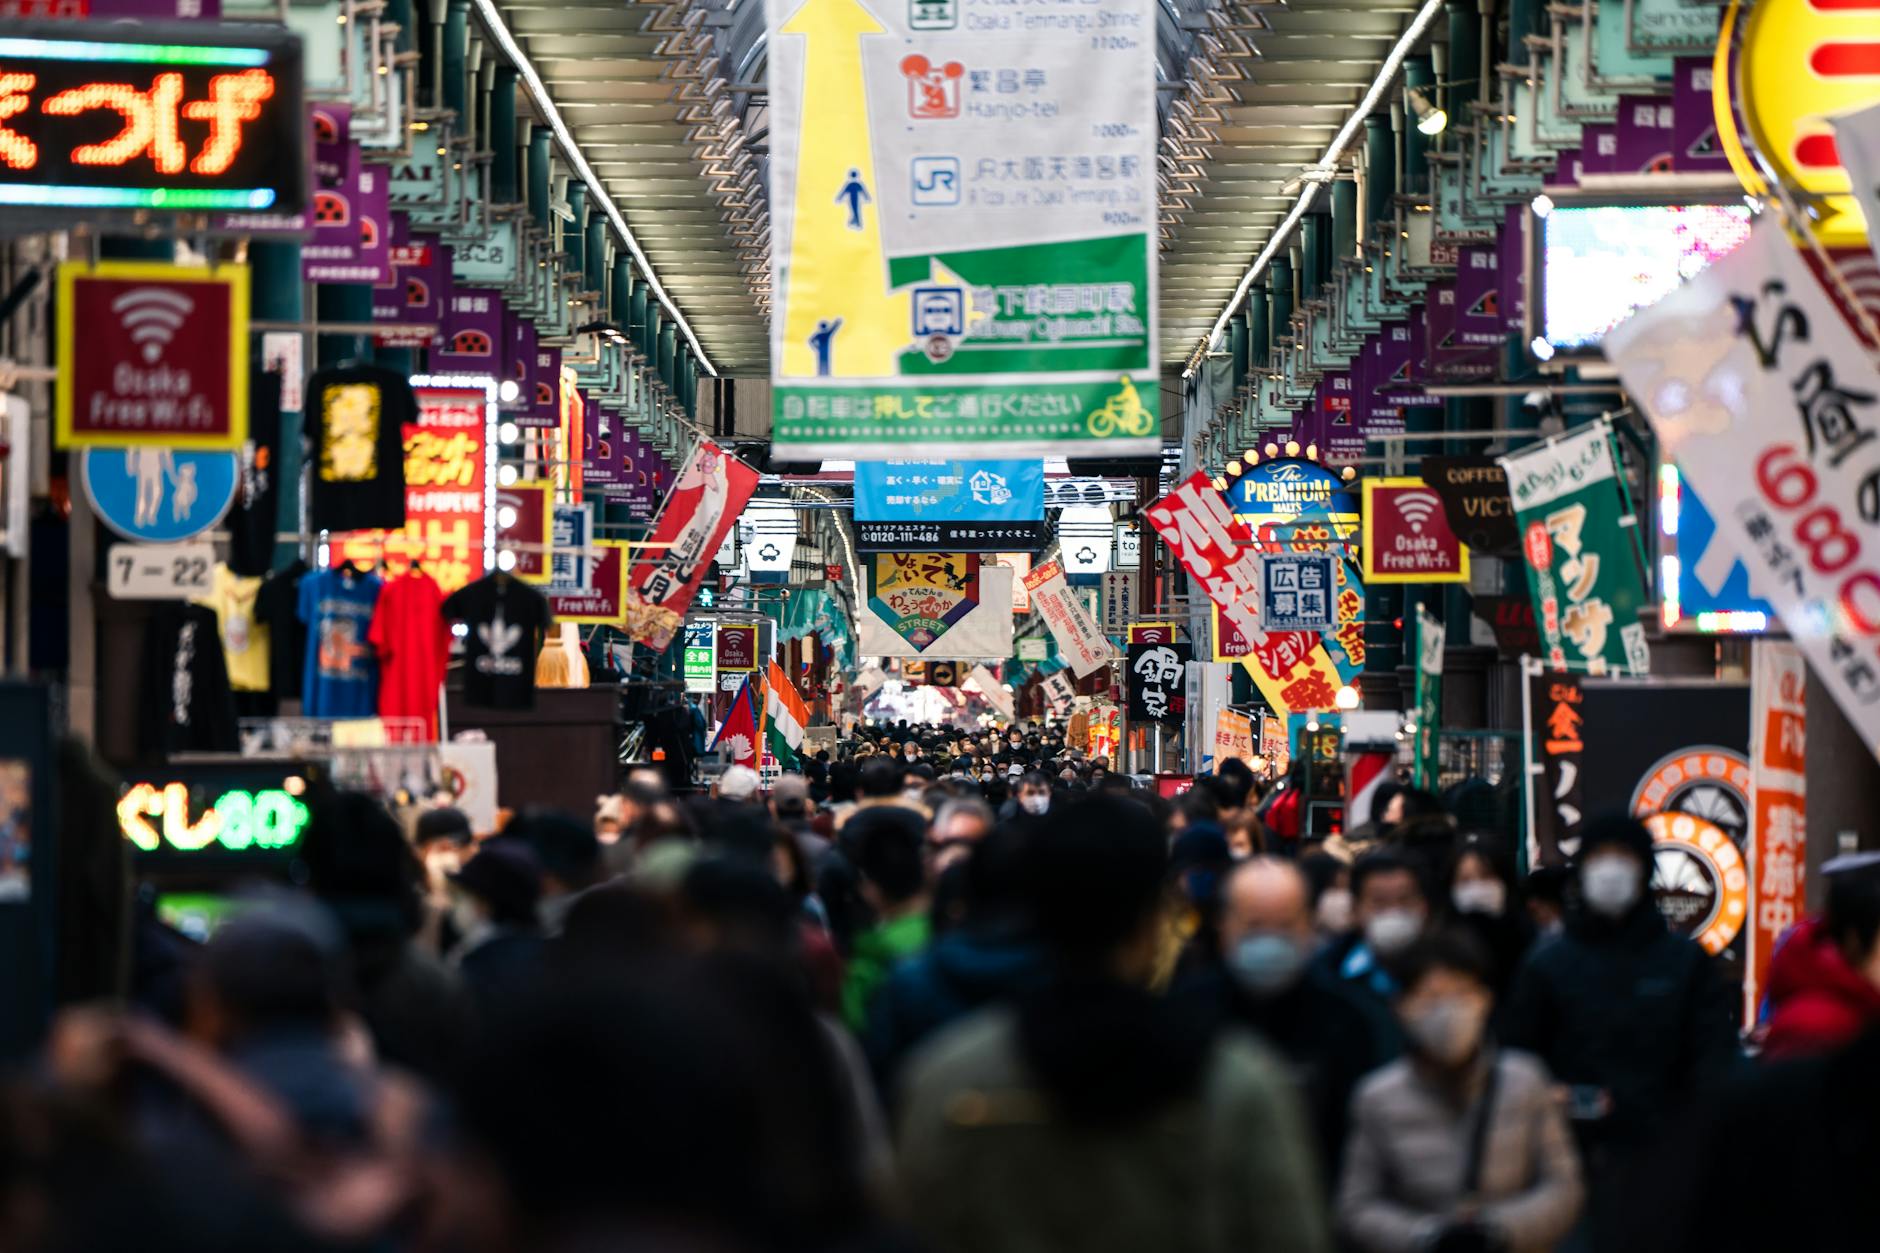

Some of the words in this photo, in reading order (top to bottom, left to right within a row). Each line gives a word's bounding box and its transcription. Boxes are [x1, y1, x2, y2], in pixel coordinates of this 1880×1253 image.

[914, 170, 955, 191] JR
[114, 362, 190, 397] Osaka
[90, 391, 148, 425] Free
[150, 393, 214, 427] Wi-Fi
[1265, 464, 1308, 483] The
[1447, 467, 1504, 484] COFFEE
[1244, 479, 1331, 502] PREMIUM
[870, 532, 940, 543] 0120-111-486
[1394, 534, 1438, 551] Osaka
[1382, 552, 1416, 569] Free
[1416, 553, 1450, 568] Wi-Fi
[1273, 566, 1323, 589] 広告
[557, 600, 583, 612] Free
[584, 600, 613, 613] Wi-Fi
[1273, 592, 1323, 615] 募集
[898, 618, 945, 632] STREET
[724, 649, 744, 657] Osaka
[1225, 643, 1249, 654] Free
[719, 657, 734, 665] Free
